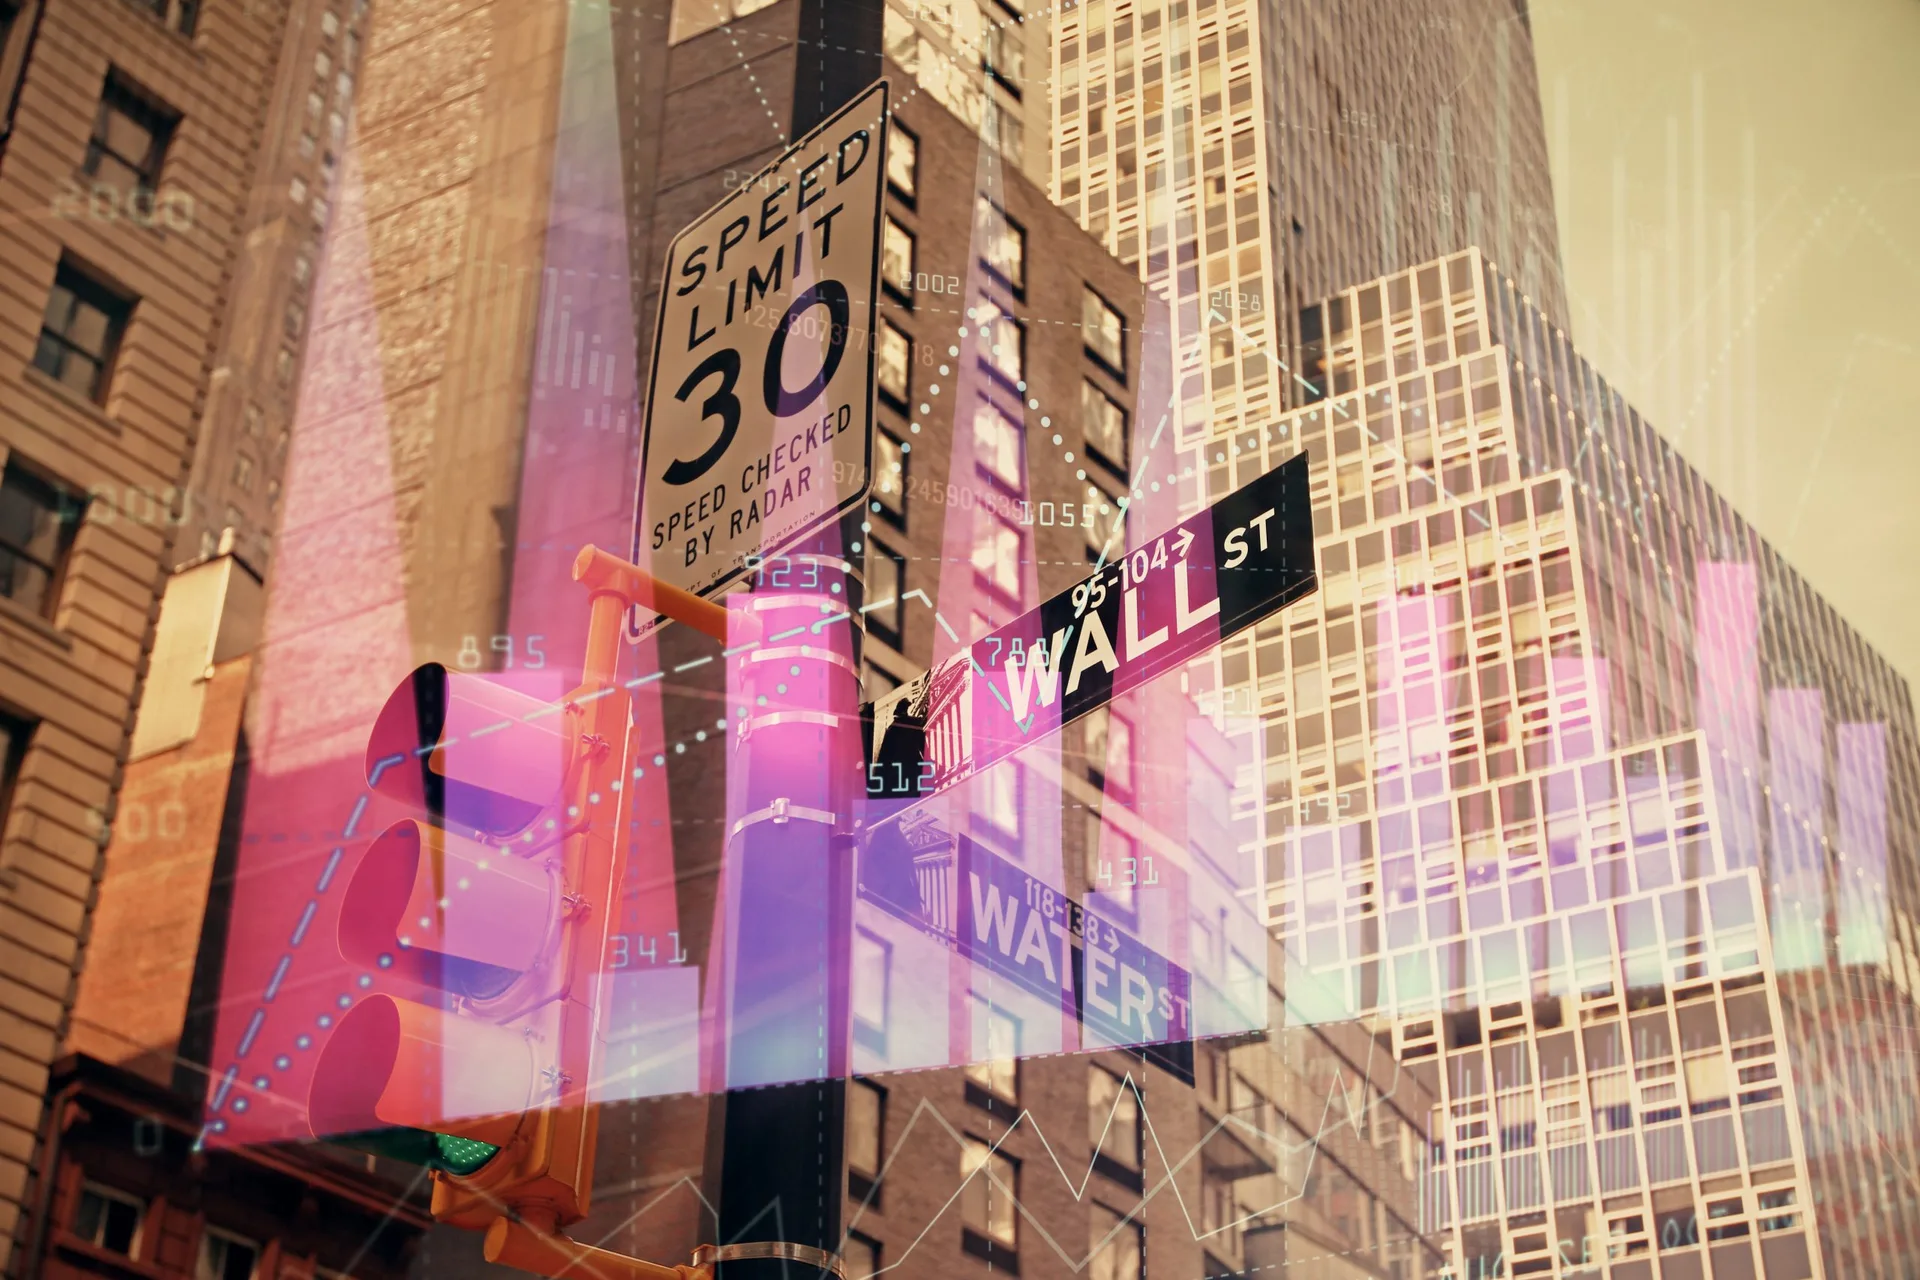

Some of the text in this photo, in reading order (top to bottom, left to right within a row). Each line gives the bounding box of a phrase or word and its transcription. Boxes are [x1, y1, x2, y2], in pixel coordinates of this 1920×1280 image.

[676, 129, 870, 296] SPEED
[687, 203, 844, 352] LIMIT
[661, 279, 850, 486] 30
[652, 403, 851, 551] SPEED CHECKED
[684, 466, 812, 569] BY RADAR
[711, 567, 723, 579] OF
[732, 510, 817, 565] TRANSPORTATION
[1004, 508, 1276, 723] WALL ST
[1071, 537, 1169, 617] 95-104
[969, 871, 1190, 1041] WATER ST
[1024, 877, 1099, 945] 118-138
